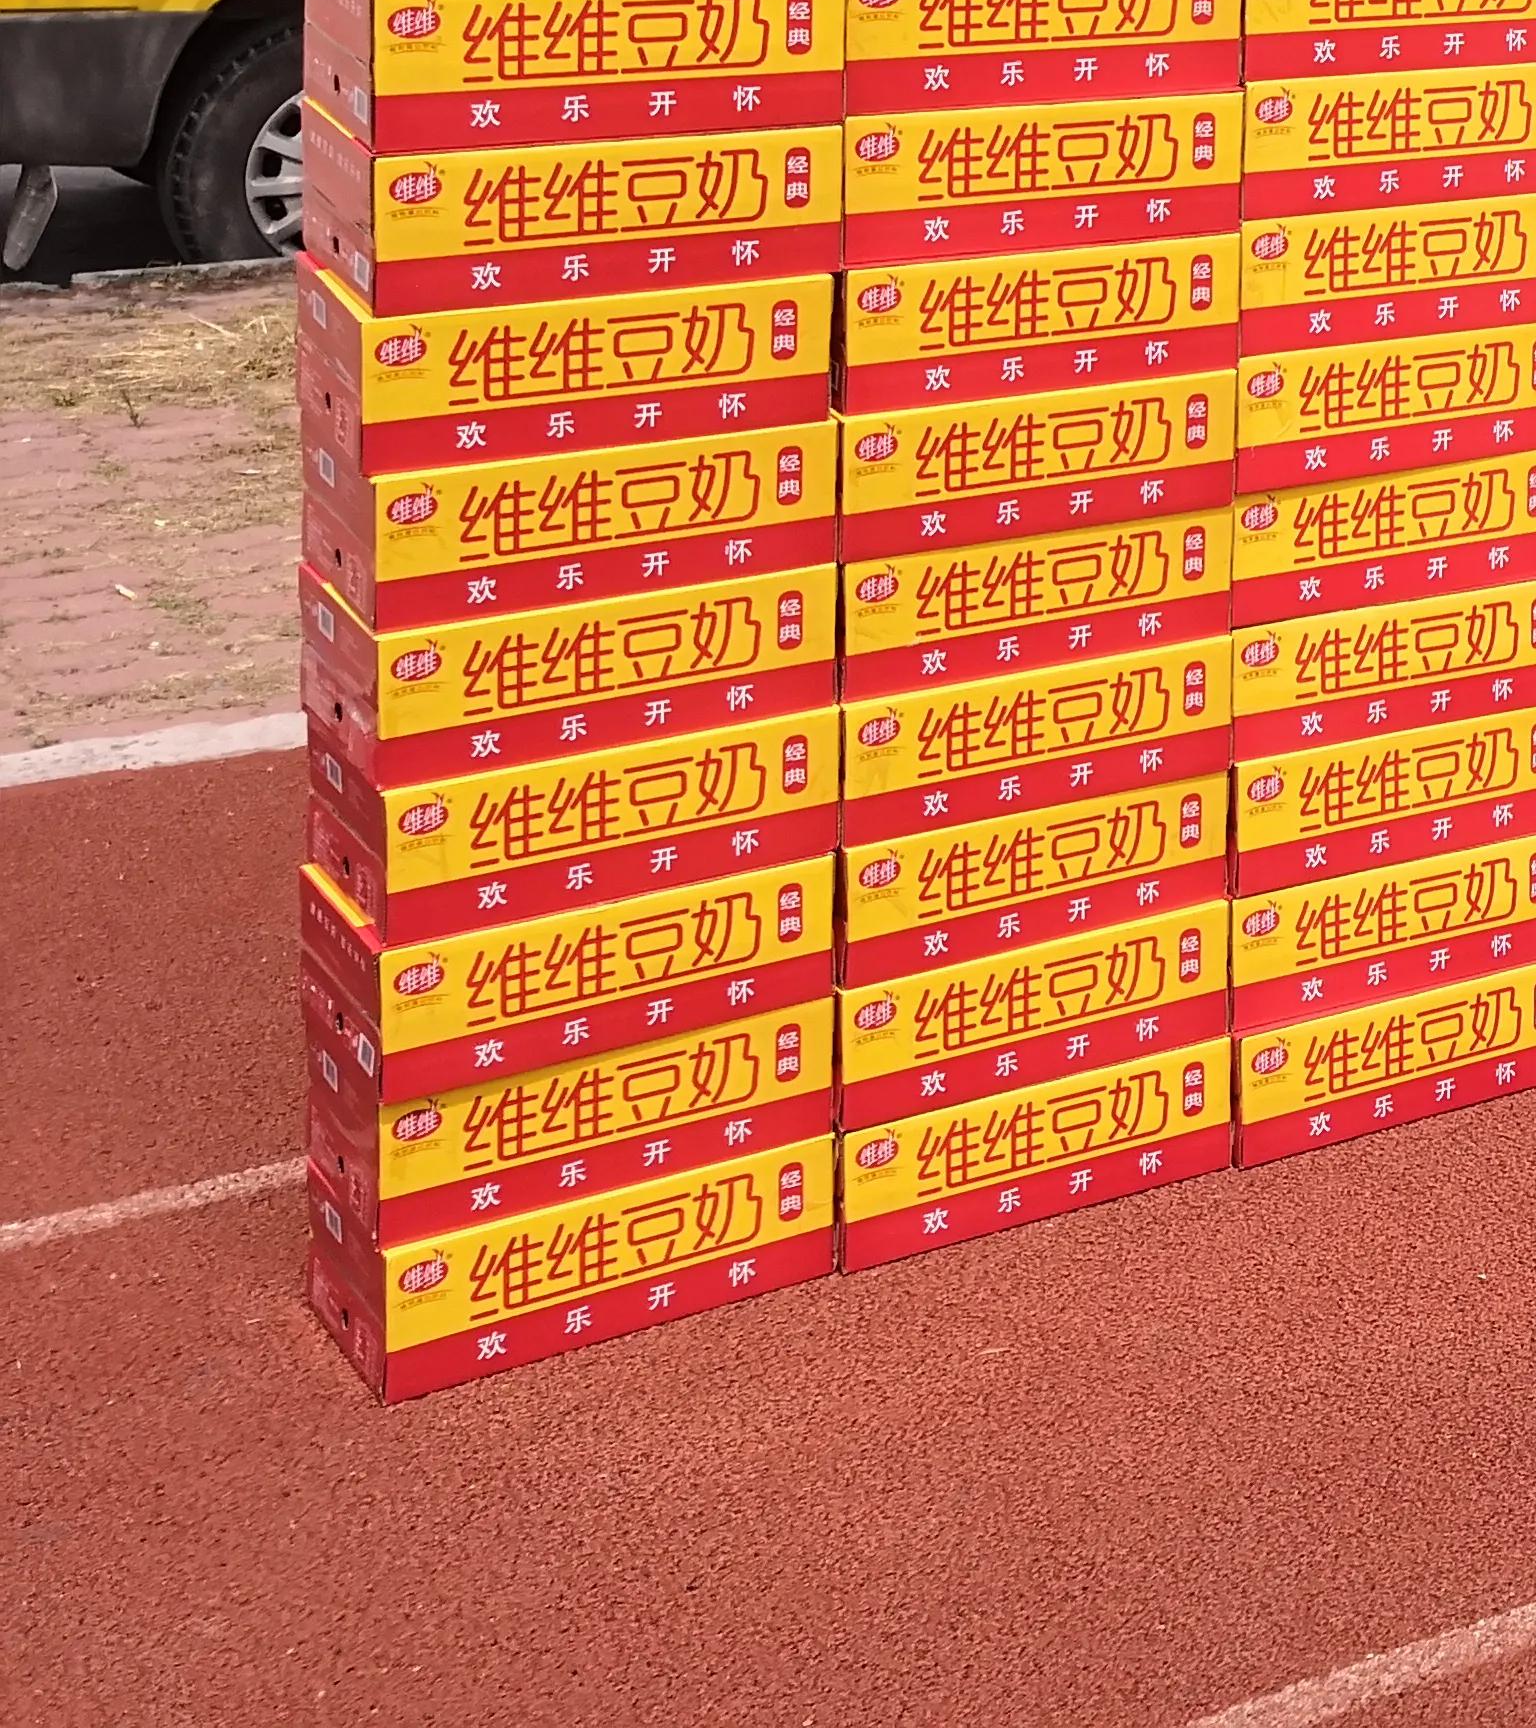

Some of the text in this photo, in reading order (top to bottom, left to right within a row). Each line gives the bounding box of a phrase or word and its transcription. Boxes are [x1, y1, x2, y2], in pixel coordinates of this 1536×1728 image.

[787, 1, 810, 47] 经典
[921, 50, 1173, 91] 欢乐开怀
[471, 82, 761, 127] 欢乐开怀
[1308, 77, 1532, 162] 维维豆奶
[465, 145, 768, 246] 维维豆奶
[786, 155, 810, 201] 经典
[917, 110, 1180, 203] 维维豆奶
[471, 237, 761, 289] 欢乐开怀
[1304, 207, 1527, 297] 维维豆奶
[772, 307, 795, 354] 经典
[917, 252, 1178, 351] 维维豆奶
[450, 298, 753, 407] 维维豆奶
[921, 338, 1171, 391] 欢乐开怀
[1298, 338, 1521, 433] 维维豆奶
[456, 390, 746, 449] 欢乐开怀
[913, 393, 1174, 498] 维维豆奶
[460, 446, 761, 562] 维维豆奶
[779, 454, 802, 501] 经典
[1293, 465, 1515, 564] 维维豆奶
[465, 538, 753, 604] 欢乐开怀
[916, 527, 1169, 636] 维维豆奶
[462, 593, 762, 715] 维维豆奶
[780, 600, 803, 647] 经典
[920, 612, 1161, 675] 欢乐开怀
[1292, 596, 1521, 702] 维维豆奶
[468, 684, 755, 756] 欢乐开怀
[919, 663, 1170, 777] 维维豆奶
[469, 738, 767, 866] 维维豆奶
[1299, 723, 1519, 833] 维维豆奶
[475, 828, 760, 907] 欢乐开怀
[916, 797, 1167, 917] 维维豆奶
[465, 889, 763, 1024] 维维豆奶
[921, 881, 1160, 955] 欢乐开怀
[1292, 852, 1519, 968] 维维豆奶
[471, 979, 755, 1064] 欢乐开怀
[915, 932, 1165, 1057] 维维豆奶
[1303, 982, 1522, 1101] 维维豆奶
[463, 1029, 759, 1170] 维维豆奶
[914, 1065, 1171, 1197] 维维豆奶
[468, 1118, 752, 1210] 欢乐开怀
[919, 1148, 1164, 1234] 欢乐开怀
[468, 1169, 764, 1318] 维维豆奶
[474, 1261, 756, 1359] 欢乐开怀
